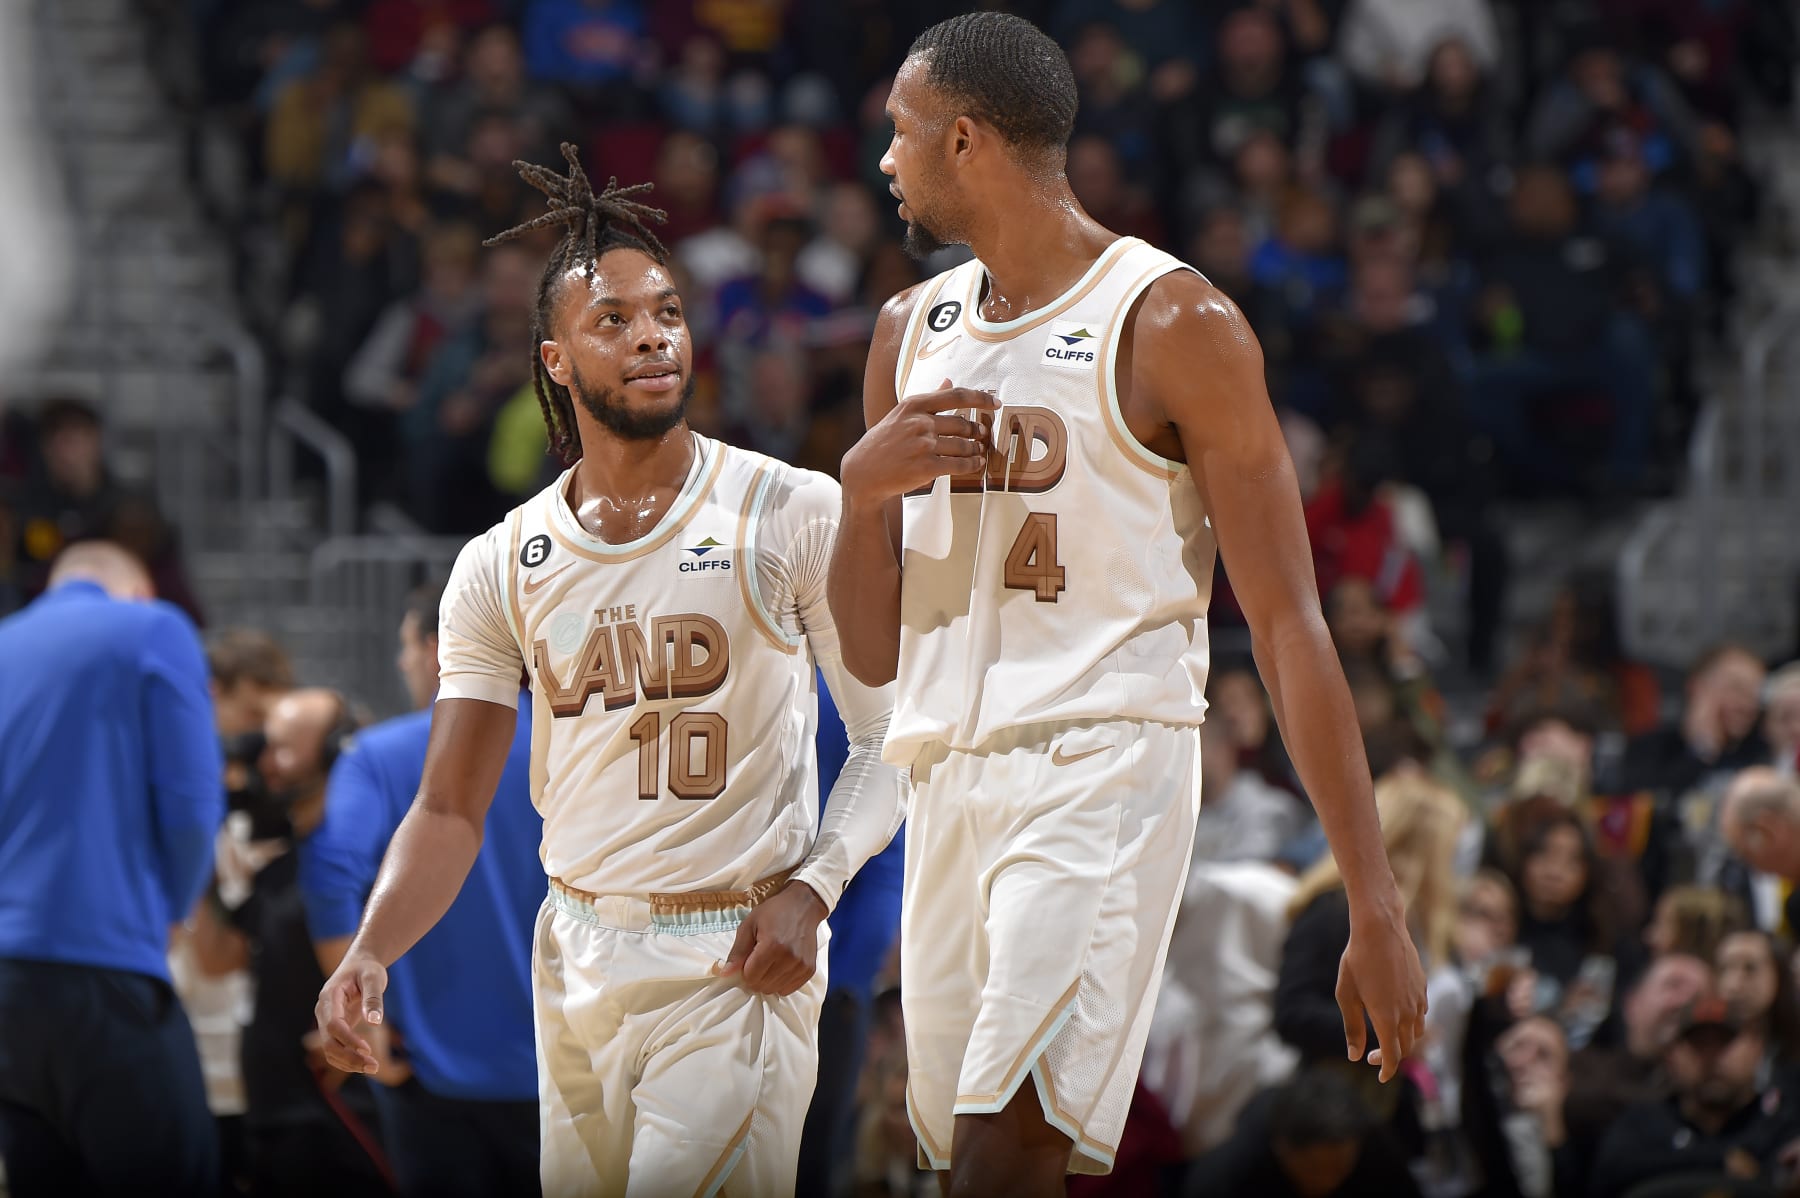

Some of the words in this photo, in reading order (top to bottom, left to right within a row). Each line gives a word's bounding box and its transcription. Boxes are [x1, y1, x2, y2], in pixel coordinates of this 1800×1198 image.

[933, 305, 954, 328] 6
[1045, 347, 1094, 362] CLIFFS
[903, 404, 1069, 495] ND
[525, 538, 545, 565] 6
[1004, 512, 1065, 603] 4
[679, 560, 731, 572] CLIFFS
[594, 604, 637, 625] THE
[532, 613, 731, 718] LAND
[629, 711, 728, 800] 10
